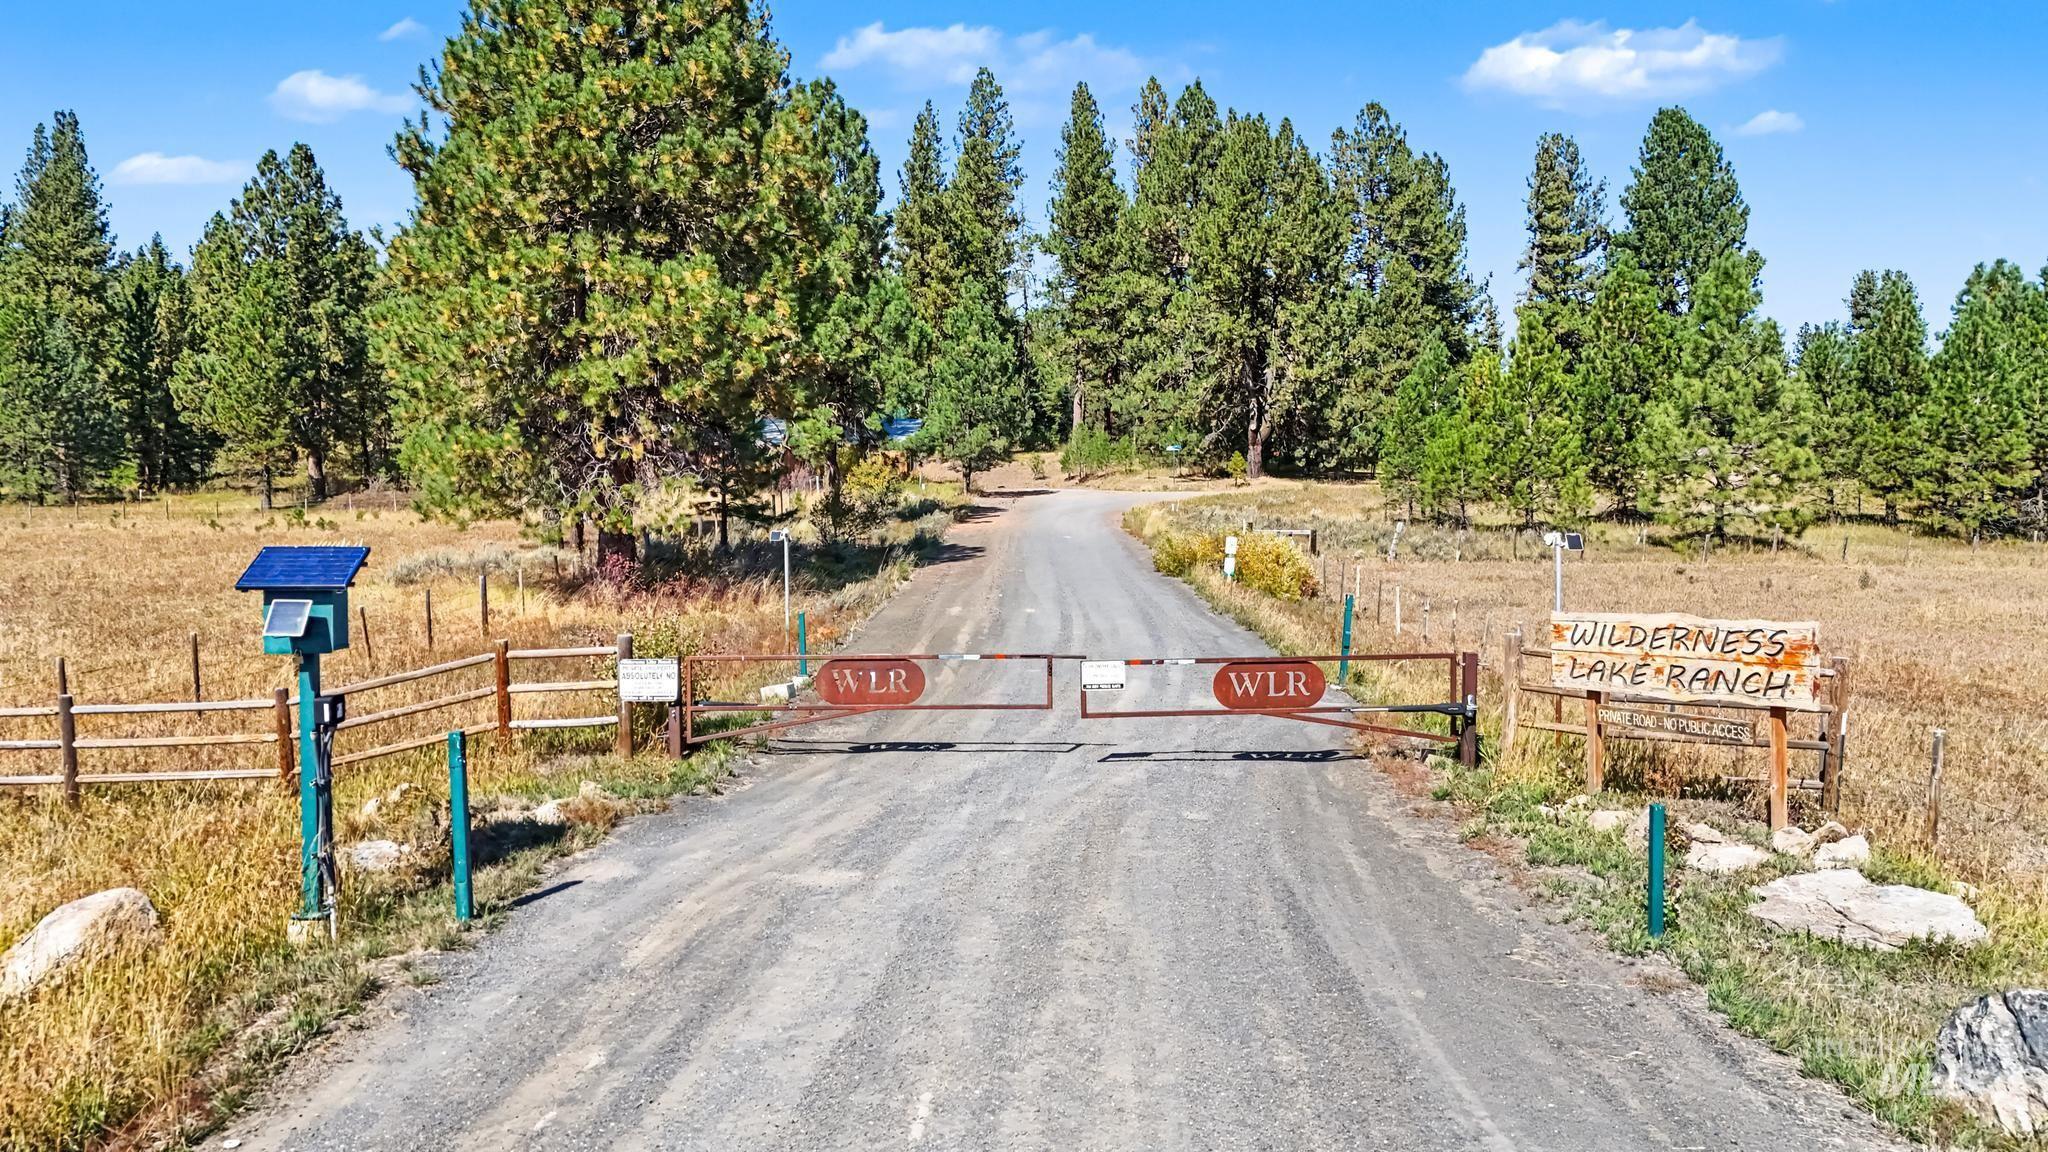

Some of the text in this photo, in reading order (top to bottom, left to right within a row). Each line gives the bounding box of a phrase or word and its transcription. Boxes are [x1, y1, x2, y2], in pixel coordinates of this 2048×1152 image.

[1570, 622, 1788, 657] WILDERNESS
[666, 672, 676, 680] NO
[832, 669, 911, 694] WLR
[1228, 671, 1311, 698] WLR
[1569, 658, 1791, 699] LAKE RANCH
[1598, 709, 1632, 725] PRIVATE
[1633, 713, 1656, 728] ROAD
[1663, 717, 1677, 731] NO
[1678, 718, 1711, 736] PUBLIC
[1711, 723, 1751, 740] ACCESS
